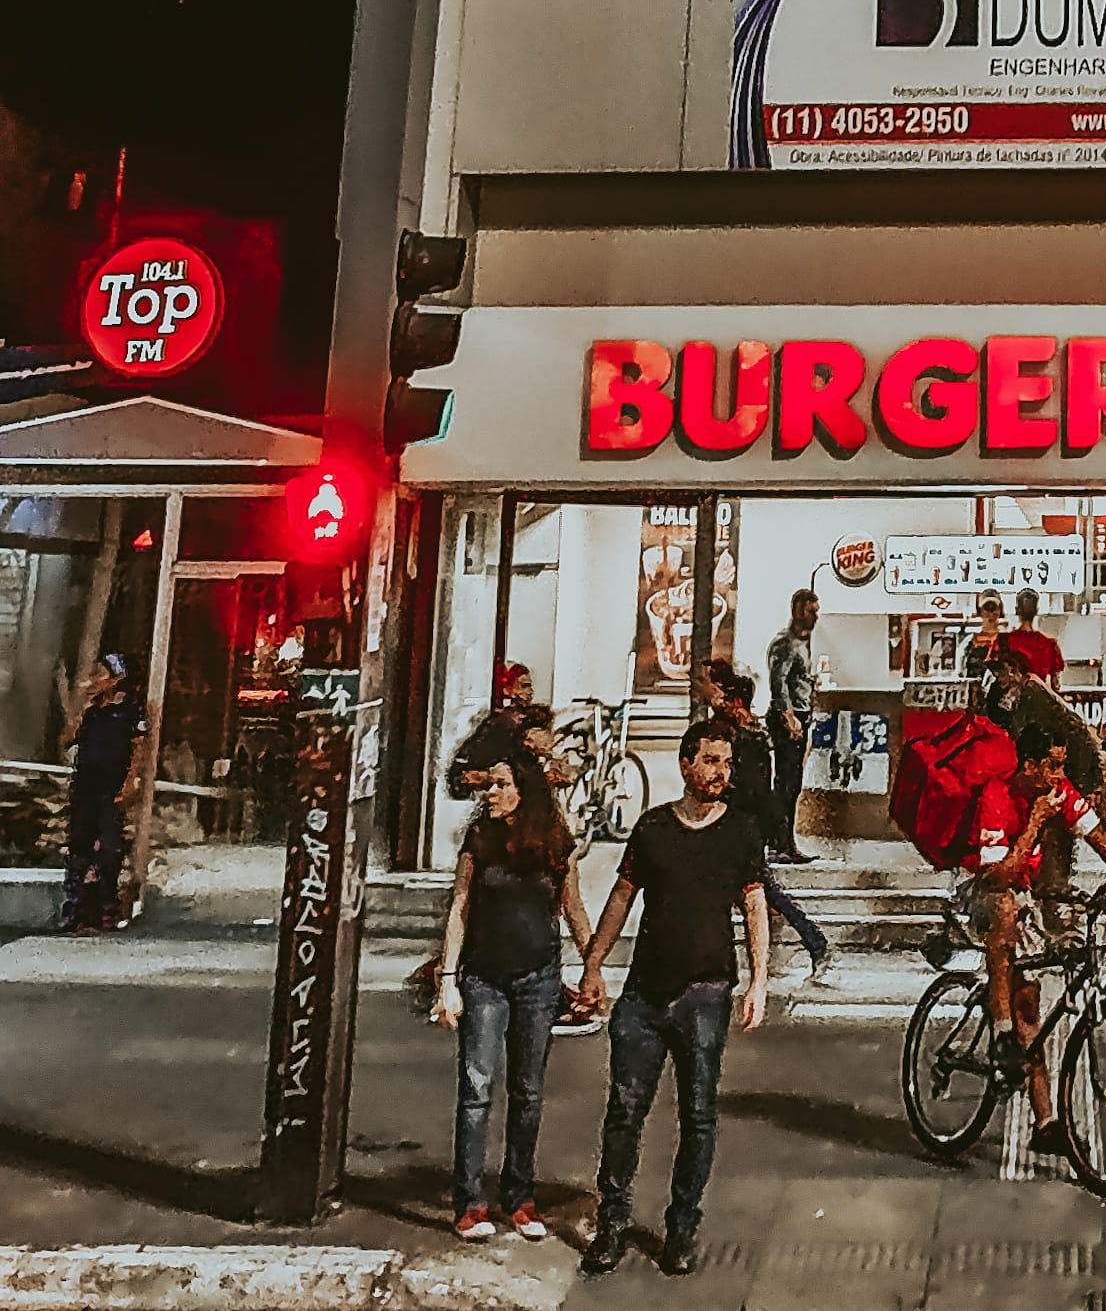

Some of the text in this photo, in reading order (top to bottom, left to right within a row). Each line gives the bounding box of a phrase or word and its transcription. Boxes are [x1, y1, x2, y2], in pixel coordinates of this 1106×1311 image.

[771, 106, 823, 139] (11)
[830, 106, 969, 134] 4053-2950
[976, 147, 992, 162] de
[140, 260, 186, 282] 104.1
[100, 274, 198, 333] Top
[125, 338, 165, 363] FM
[650, 503, 732, 526] BALO
[837, 550, 876, 569] KING
